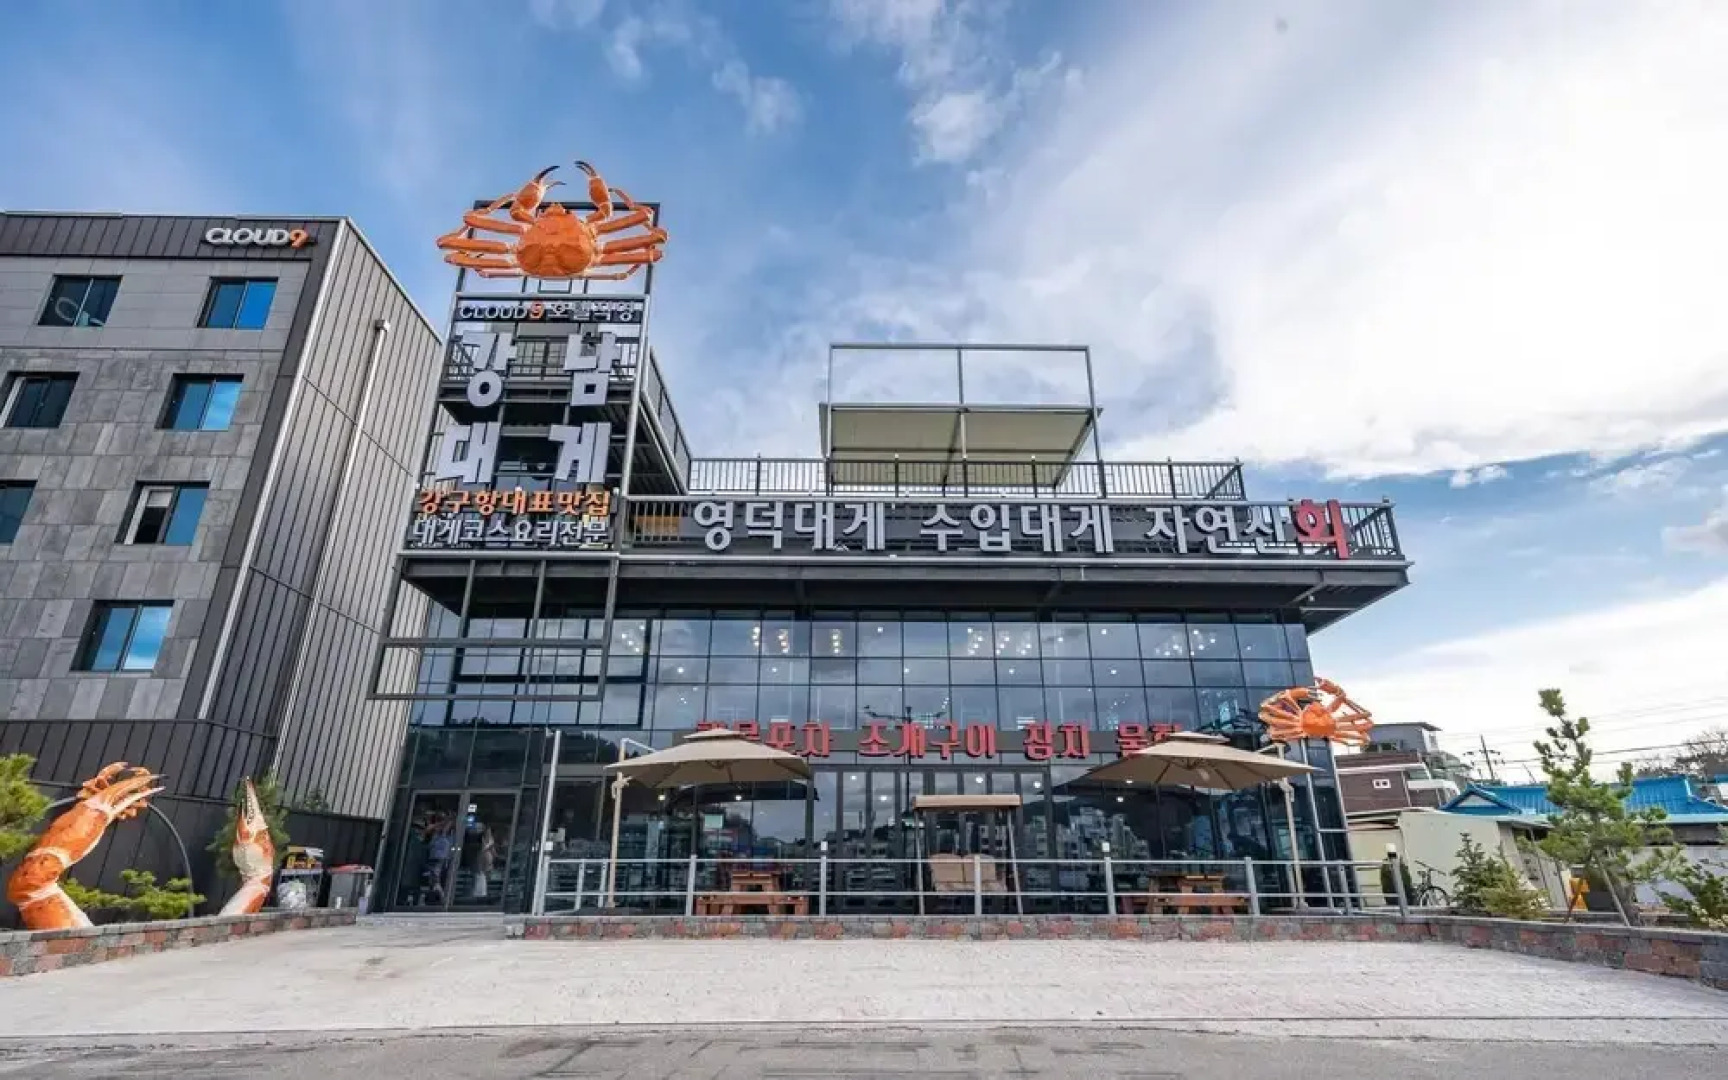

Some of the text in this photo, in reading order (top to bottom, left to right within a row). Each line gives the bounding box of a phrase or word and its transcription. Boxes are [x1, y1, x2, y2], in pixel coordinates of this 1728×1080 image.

[205, 228, 309, 250] CLOUD9
[459, 300, 544, 319] CLOUD9
[461, 331, 622, 408] 강남
[434, 421, 612, 483] 대게
[693, 500, 886, 551] 영덕대게
[920, 503, 1114, 552] 수입대게
[697, 718, 834, 758] 포차
[857, 720, 998, 760] 조개구이
